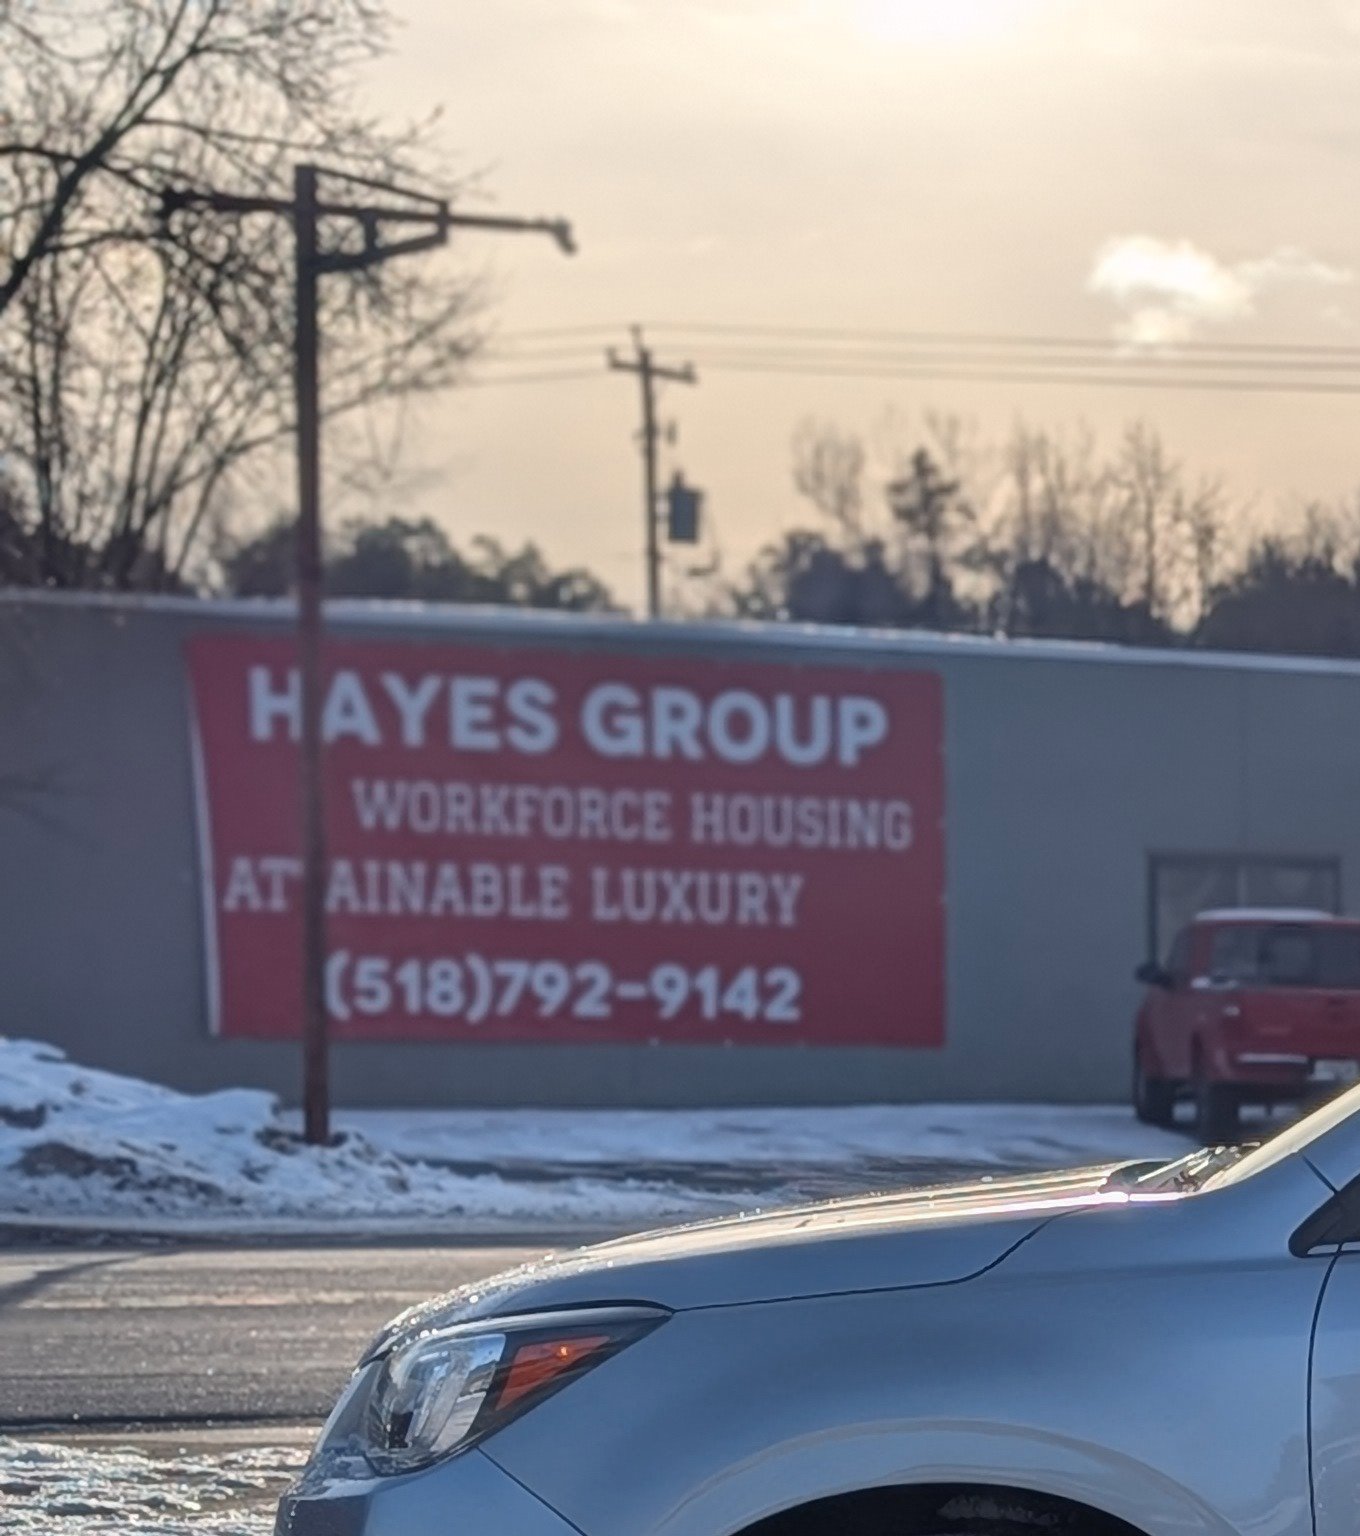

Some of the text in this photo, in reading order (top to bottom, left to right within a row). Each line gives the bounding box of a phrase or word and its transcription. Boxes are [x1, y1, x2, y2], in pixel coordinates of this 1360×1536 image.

[248, 665, 889, 767] HAYES GROUP
[351, 779, 913, 850] WORKFORCE HOUSING
[223, 856, 803, 926] ATAINABLE LUXURY
[324, 949, 801, 1024] (518)792-9142
